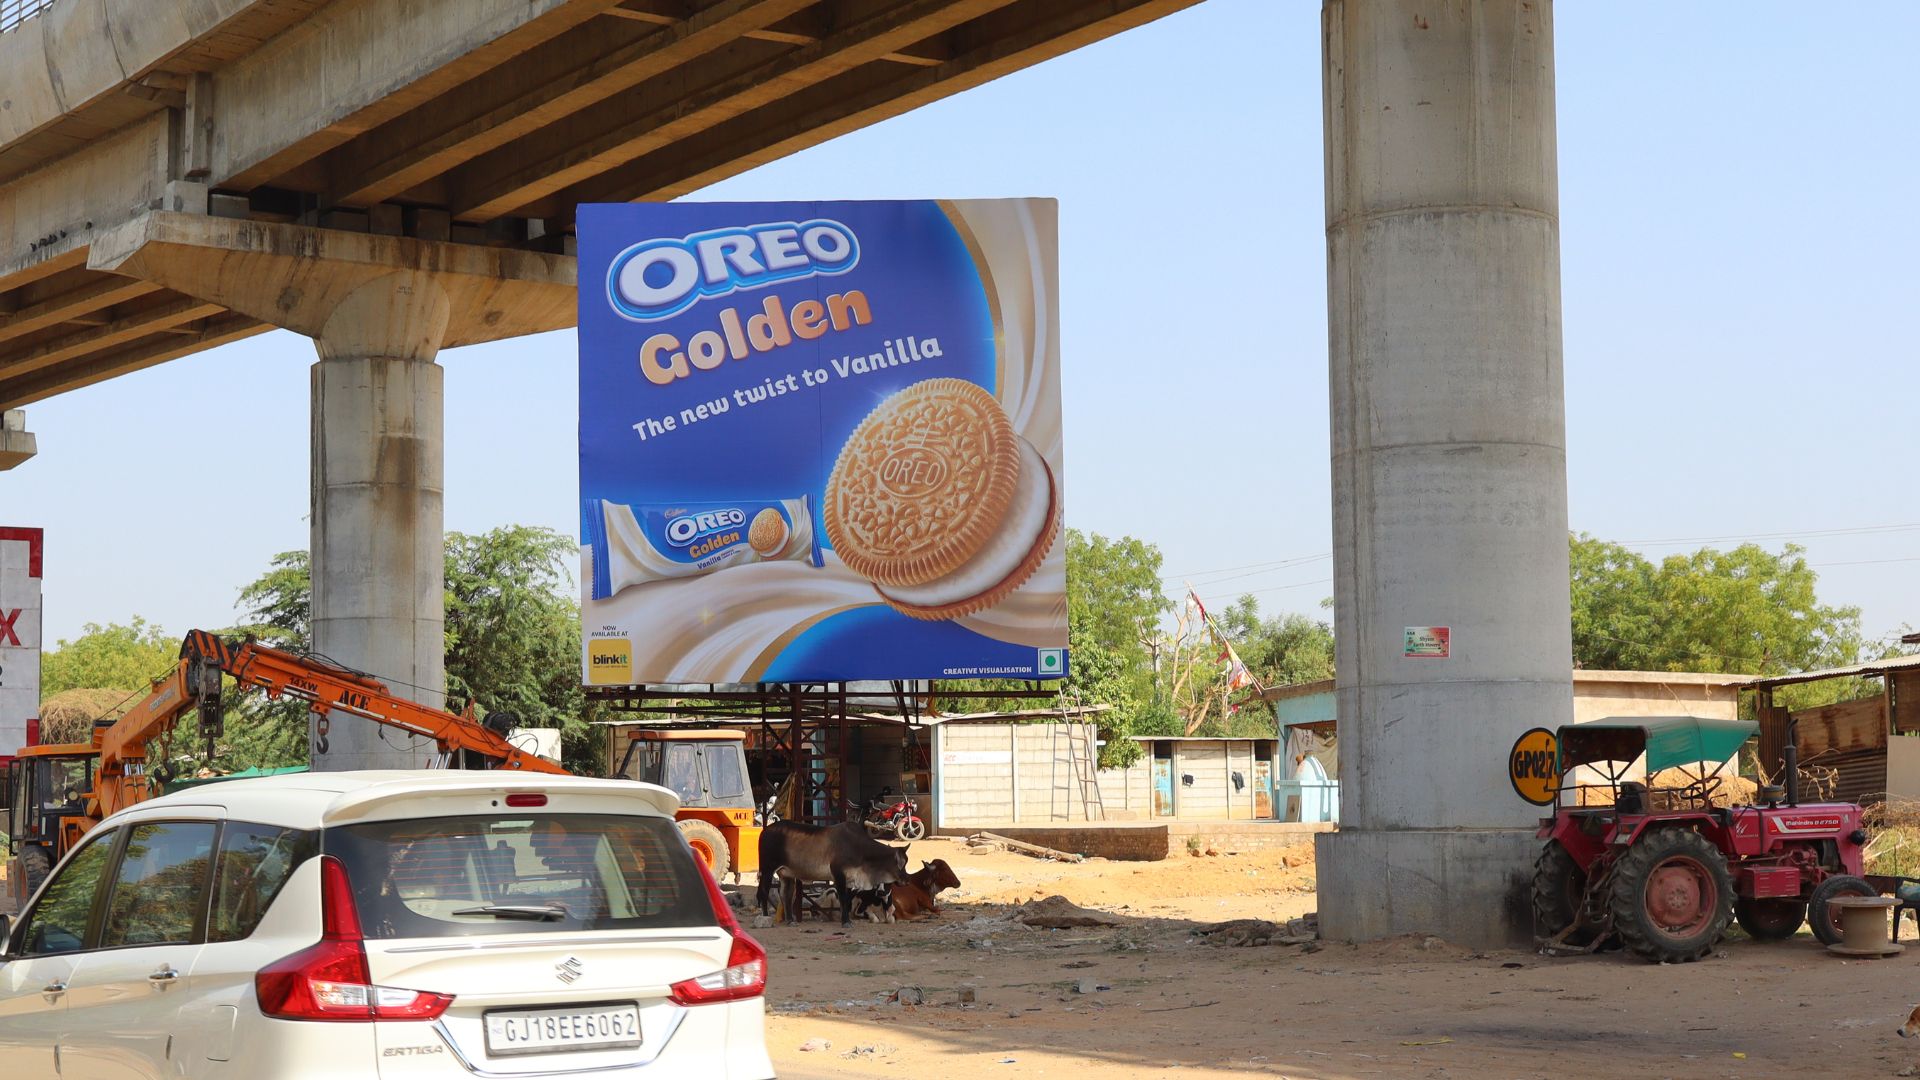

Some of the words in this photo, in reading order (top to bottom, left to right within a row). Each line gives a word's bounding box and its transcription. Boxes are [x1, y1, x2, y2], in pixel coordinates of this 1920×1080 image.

[619, 225, 850, 307] OREO
[639, 289, 873, 385] Golden
[632, 413, 677, 441] The
[679, 396, 730, 426] new
[733, 373, 799, 408] twist
[802, 368, 829, 388] to
[831, 335, 943, 379] Vanilla
[883, 458, 940, 486] OREO
[669, 509, 744, 541] OREO
[689, 531, 740, 558] Golden
[697, 555, 721, 570] Vanilla
[592, 654, 628, 665] blinkit
[943, 667, 978, 675] CREATIVE
[978, 666, 1032, 674] VISUALISATION
[289, 677, 318, 692] 14XW
[339, 690, 371, 710] ACE
[1514, 750, 1557, 779] GP027
[505, 1012, 636, 1042] GJ18EE6062
[383, 1045, 443, 1057] ERTIGA
